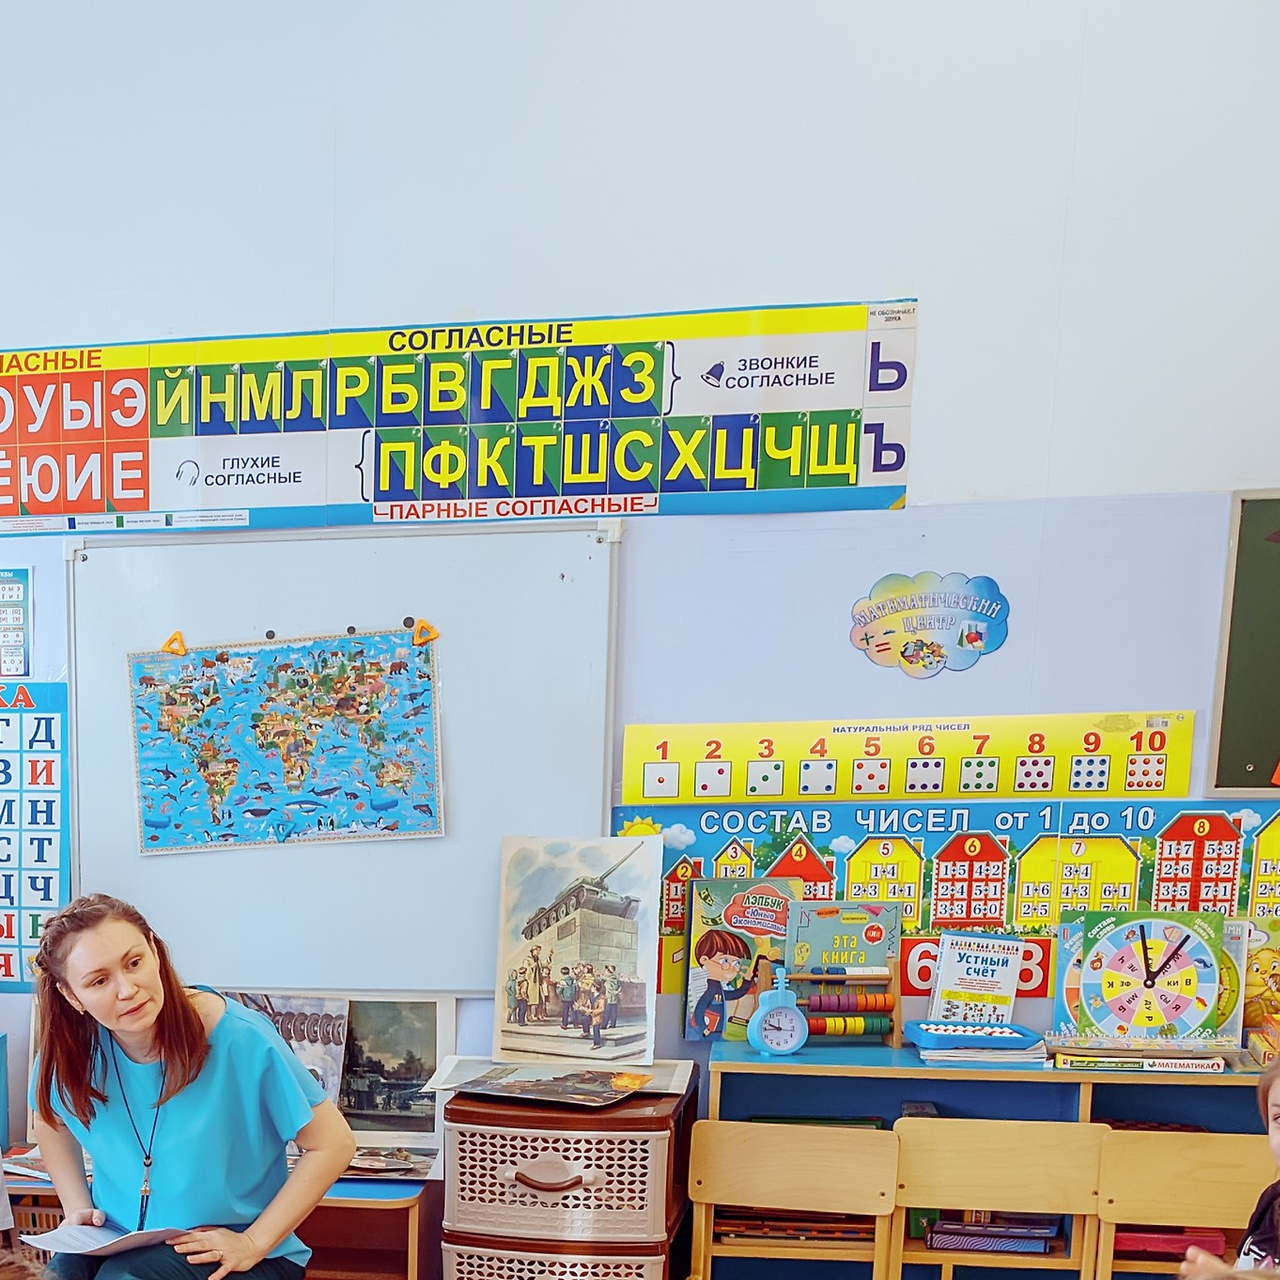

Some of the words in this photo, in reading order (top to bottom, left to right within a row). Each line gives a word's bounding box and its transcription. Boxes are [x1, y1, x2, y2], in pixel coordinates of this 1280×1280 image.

[388, 323, 573, 352] СОГЛАСНЫЕ
[737, 355, 819, 371] ЗВОНКИЕ
[868, 341, 908, 392] Ь
[725, 371, 835, 390] СОГЛАСНЫЕ
[25, 384, 57, 432] У
[63, 381, 101, 430] Ы
[111, 379, 146, 427] Э
[157, 368, 190, 425] Й
[201, 375, 235, 422] Н
[242, 372, 281, 421] М
[286, 371, 323, 419] Л
[336, 367, 370, 416] Р
[382, 363, 420, 413] Б
[429, 361, 467, 412] В
[480, 359, 511, 409] Г
[518, 357, 562, 418] Д
[565, 355, 611, 407] Ж
[619, 351, 656, 404] З
[380, 442, 414, 491] П
[422, 439, 467, 490] Ф
[479, 438, 511, 487] К
[521, 435, 556, 485] Т
[563, 433, 608, 484] Ш
[613, 429, 655, 482] С
[664, 428, 706, 481] Х
[714, 427, 755, 489] Ц
[764, 425, 803, 477] Ч
[808, 423, 858, 485] Щ
[864, 422, 906, 472] Ъ
[222, 456, 281, 470] ГЛУХИЕ
[21, 457, 60, 503] Ю
[68, 453, 101, 501] И
[113, 452, 143, 499] Е
[204, 471, 303, 487] СОГЛАСНЫЕ
[388, 499, 489, 521] ПАРНЫЕ
[495, 496, 644, 519] СОГЛАСНЫЕ
[854, 592, 1002, 628] МАТЕМАТИЧЕСКИЙ
[902, 614, 956, 635] ЦЕНТР
[28, 717, 55, 750] Д
[832, 724, 909, 734] НАТУРАЛЬНЫЙ
[912, 723, 933, 733] РЯД
[935, 722, 970, 731] ЧИСЕЛ
[656, 740, 669, 760] 1
[705, 740, 722, 760] 2
[757, 739, 775, 758] 3
[809, 738, 827, 758] 4
[864, 736, 881, 757] 5
[918, 735, 935, 756] 6
[972, 734, 990, 755] 7
[1027, 733, 1045, 754] 8
[1083, 732, 1101, 753] 9
[1129, 730, 1167, 752] 10
[28, 760, 56, 786] И
[28, 800, 56, 825] Н
[700, 809, 833, 835] СОСТАВ
[856, 808, 970, 835] ЧИСЕЛ
[995, 812, 1030, 831] от
[1038, 806, 1052, 830] 1
[1068, 812, 1110, 835] до
[1120, 806, 1155, 830] 10
[1198, 821, 1206, 834] 8
[30, 838, 52, 864] Т
[731, 846, 738, 859] 3
[794, 846, 803, 858] 4
[882, 843, 890, 856] 5
[968, 840, 977, 853] 6
[1075, 842, 1082, 854] 7
[680, 866, 689, 878] 2
[28, 876, 53, 902] Ч
[743, 893, 784, 910] ЛЭПБУК
[906, 941, 936, 991] 6
[957, 952, 1009, 967] Устный
[966, 966, 997, 978] счёт
[1157, 1062, 1211, 1070] МАТЕМАТИКА
